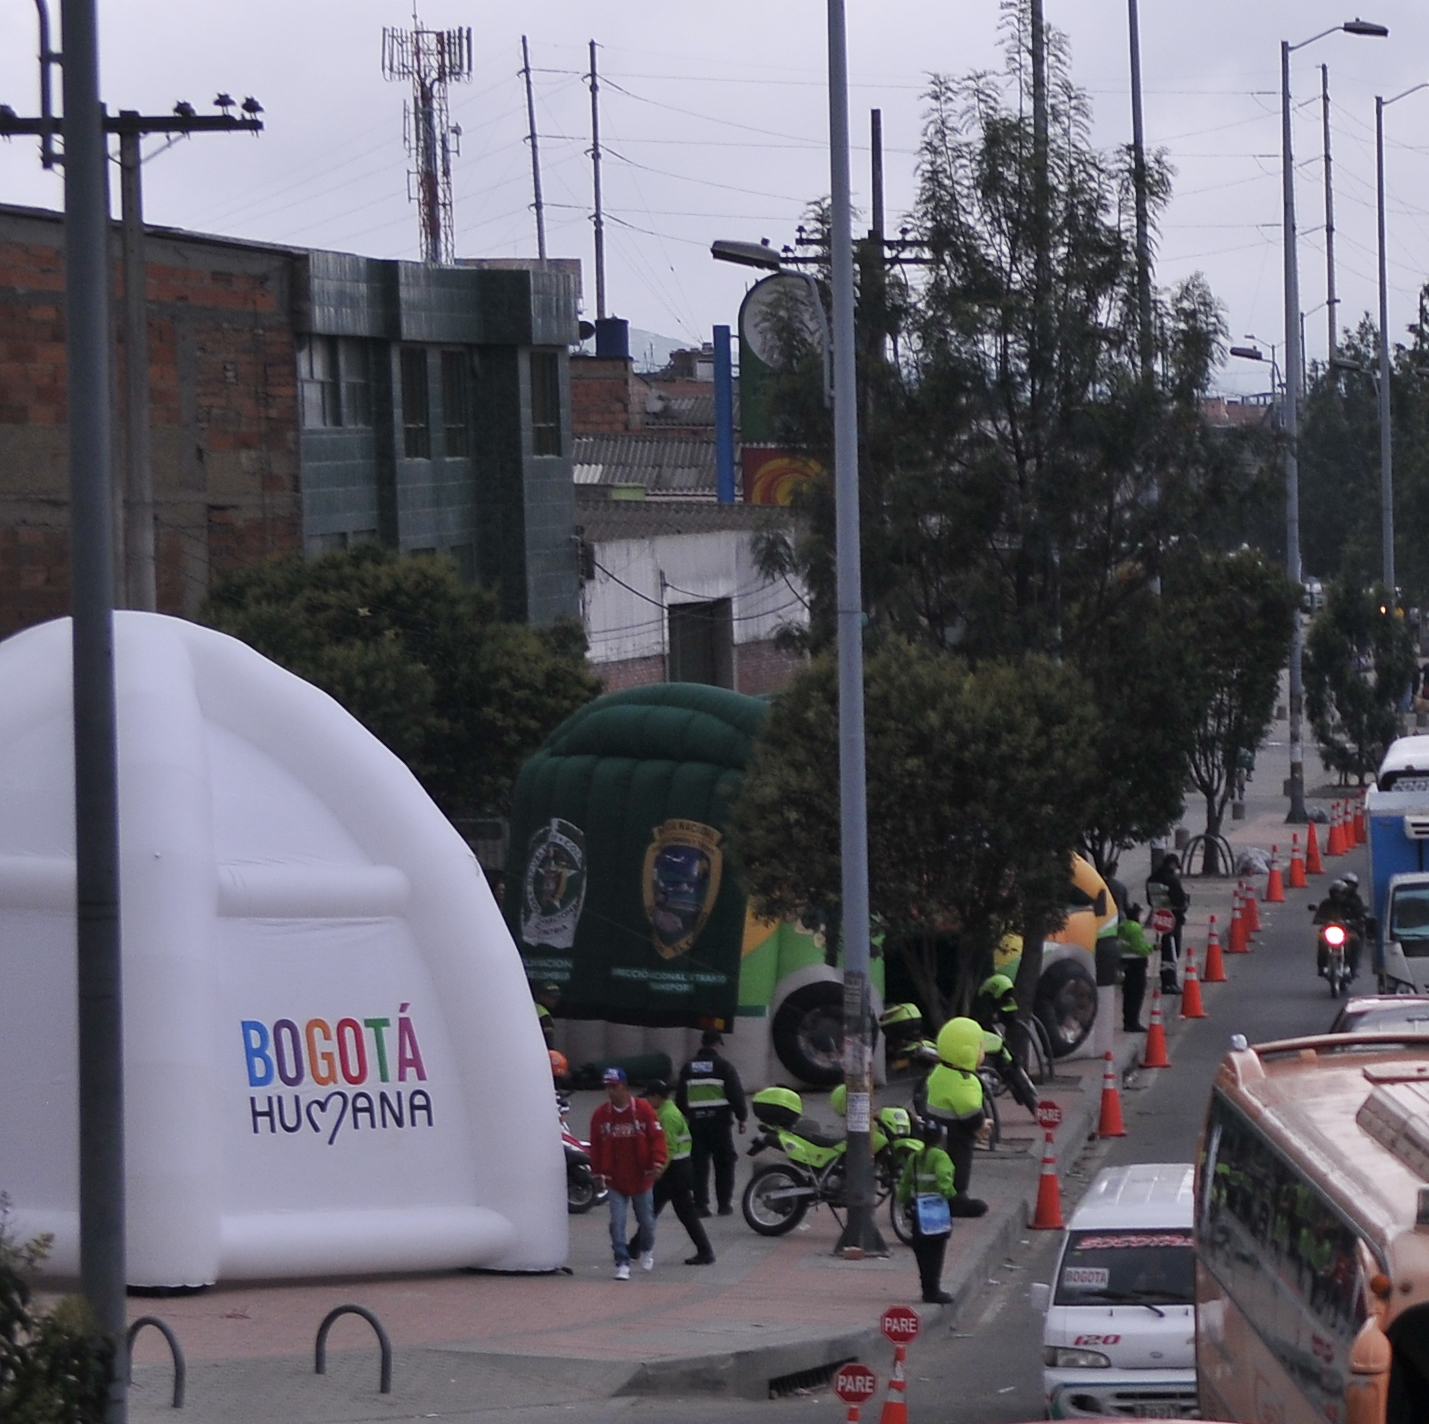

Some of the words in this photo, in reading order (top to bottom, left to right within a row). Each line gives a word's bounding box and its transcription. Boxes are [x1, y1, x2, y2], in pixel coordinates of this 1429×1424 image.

[241, 1002, 428, 1087] BOGOTÁ
[250, 1089, 434, 1146] HUMANA
[1036, 1107, 1062, 1122] PARE
[884, 1317, 917, 1333] PARE
[1074, 1334, 1121, 1346] 120
[837, 1375, 875, 1394] PARE
